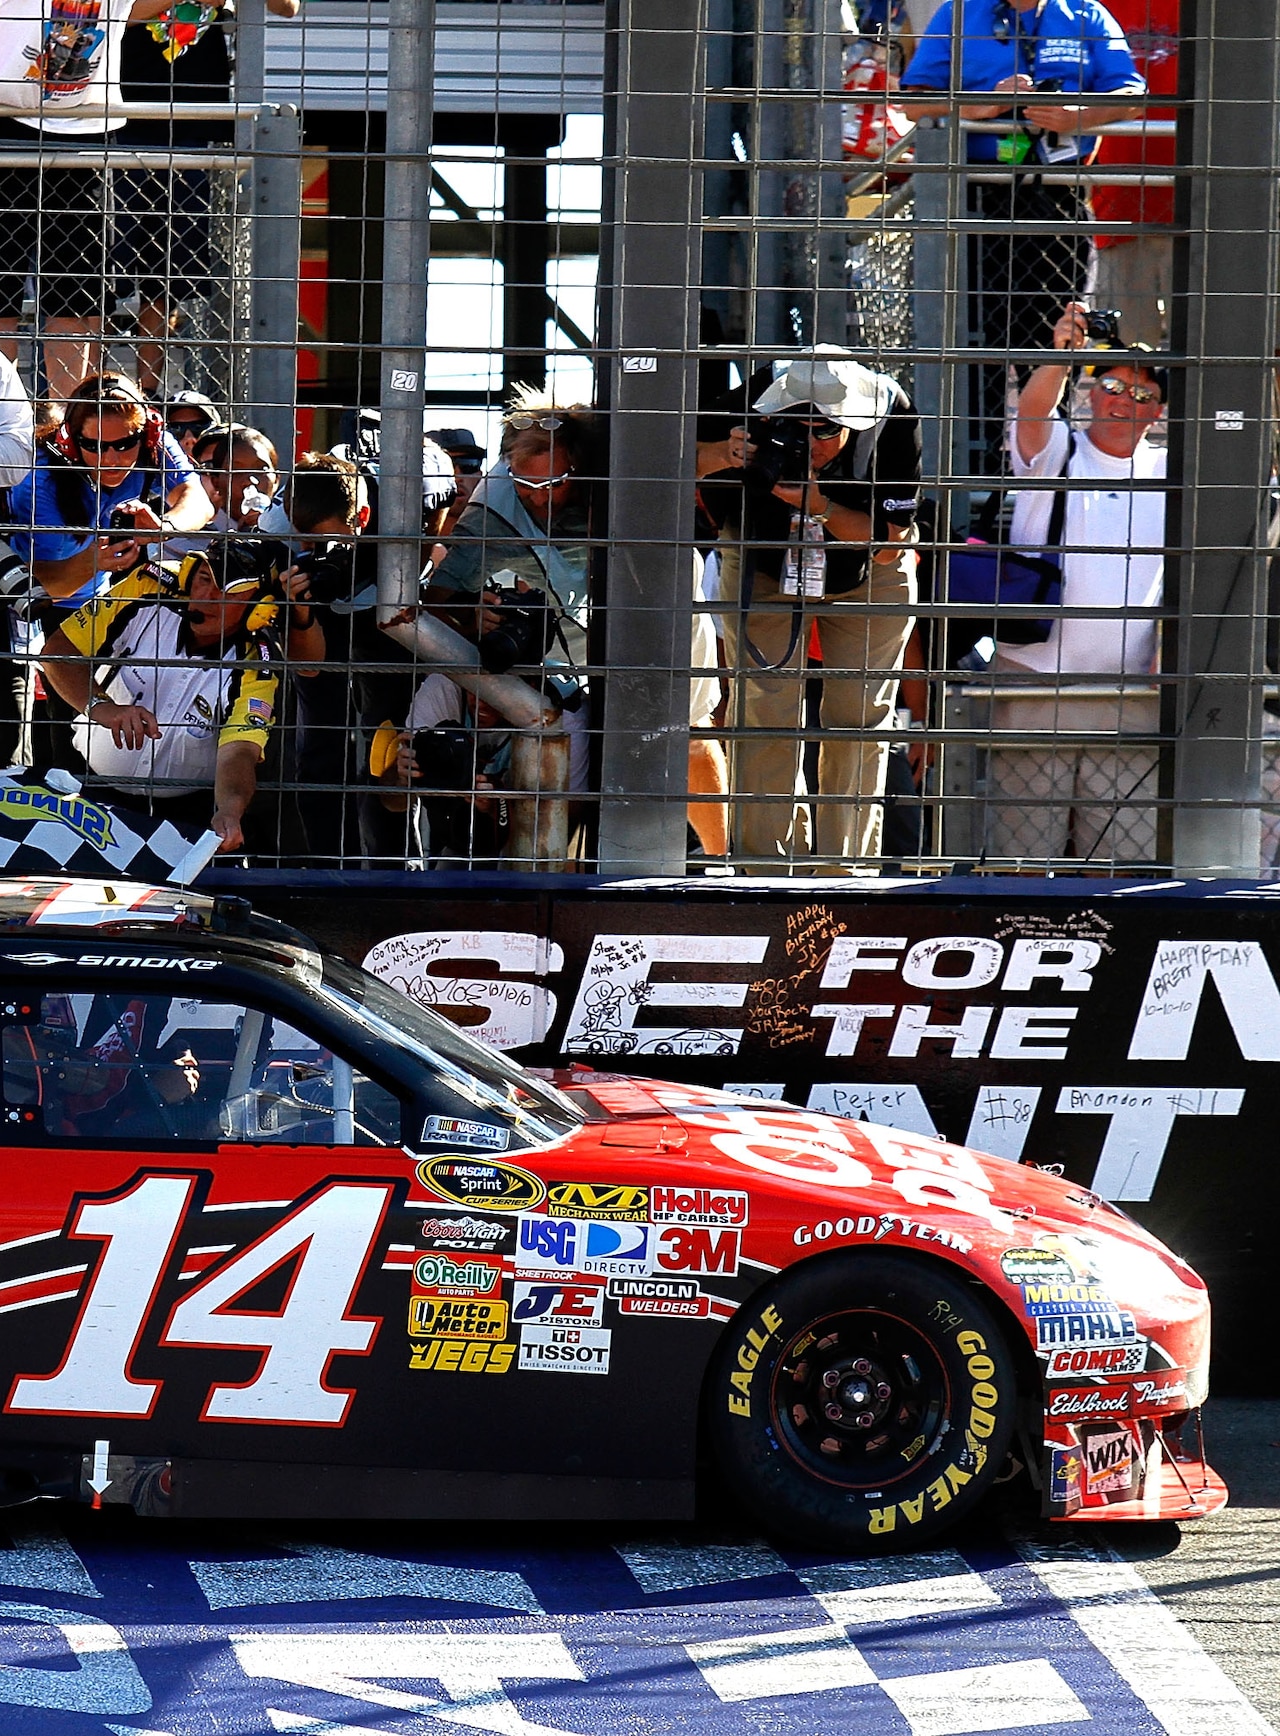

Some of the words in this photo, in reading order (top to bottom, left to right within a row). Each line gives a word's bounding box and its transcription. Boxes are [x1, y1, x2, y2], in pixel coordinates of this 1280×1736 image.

[393, 373, 416, 390] 20
[819, 936, 1101, 991] FOR
[1160, 945, 1199, 968] HAPPY
[810, 1005, 1080, 1060] THE
[833, 1090, 906, 1110] Peter
[1071, 1089, 1152, 1108] Brandon
[984, 1089, 1031, 1129] #88
[456, 1121, 496, 1138] NASCAR
[453, 1166, 496, 1178] NASCAR
[460, 1178, 502, 1192] Sprint
[465, 1197, 490, 1205] CUP
[491, 1198, 528, 1206] SERIES
[653, 1189, 746, 1224] Holley
[548, 1205, 611, 1220] MECHANIX
[613, 1209, 648, 1221] WEAR
[653, 1213, 674, 1221] HP
[678, 1214, 729, 1224] CARBS
[422, 1219, 464, 1239] Coors
[465, 1227, 510, 1240] LIGHT
[433, 1240, 496, 1250] POLE
[521, 1220, 576, 1265] USG
[657, 1228, 738, 1273] 3M
[420, 1258, 497, 1288] O'Reilly
[515, 1269, 576, 1280] SHEETROCK
[8, 1174, 395, 1424] 14
[613, 1282, 693, 1298] LINCOLN
[1025, 1284, 1106, 1304] MOOG
[437, 1303, 491, 1318] Auto
[514, 1286, 599, 1320] JE
[630, 1300, 700, 1314] WELDERS
[431, 1318, 502, 1334] Meter
[539, 1317, 601, 1326] PISTONS
[1038, 1313, 1135, 1344] MAHLE
[409, 1340, 517, 1373] JEGS
[522, 1344, 609, 1362] TISSOT
[728, 1303, 784, 1418] EAGLE
[1052, 1349, 1128, 1372] COMP
[1050, 1391, 1128, 1415] Edelbrock
[1088, 1432, 1130, 1473] WIX
